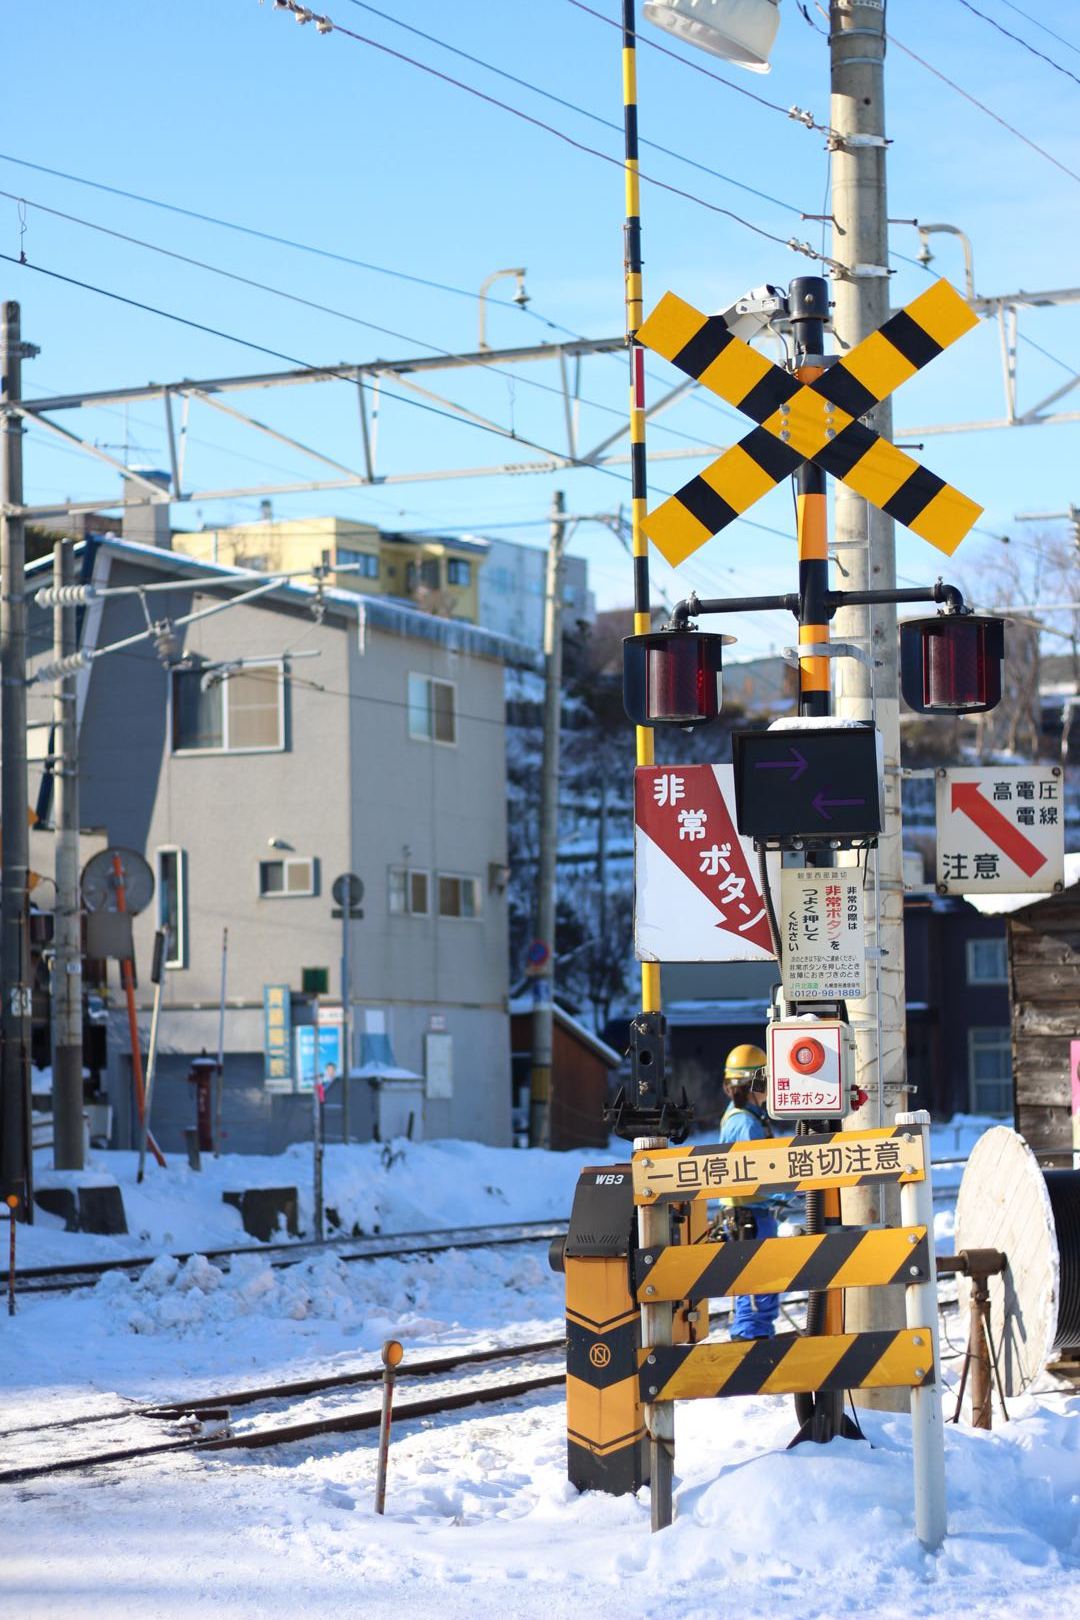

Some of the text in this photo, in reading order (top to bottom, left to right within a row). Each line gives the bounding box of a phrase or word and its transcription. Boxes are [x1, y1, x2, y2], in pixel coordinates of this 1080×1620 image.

[993, 781, 1058, 800] 高電圧
[1016, 806, 1058, 826] 電線
[653, 774, 767, 931] 非常ボタン
[943, 853, 1000, 880] 注意
[802, 888, 819, 941] つよく押して
[825, 885, 841, 950] 非常ボタンを
[847, 886, 858, 930] 非常の際は
[788, 911, 799, 952] ください
[789, 971, 860, 979] 故障におきづきのとき
[795, 989, 861, 997] 0120-98-1889
[777, 1092, 837, 1106] 非常ボタン
[647, 1142, 901, 1189] 一旦停止・踏切注意
[595, 1174, 624, 1185] WB3
